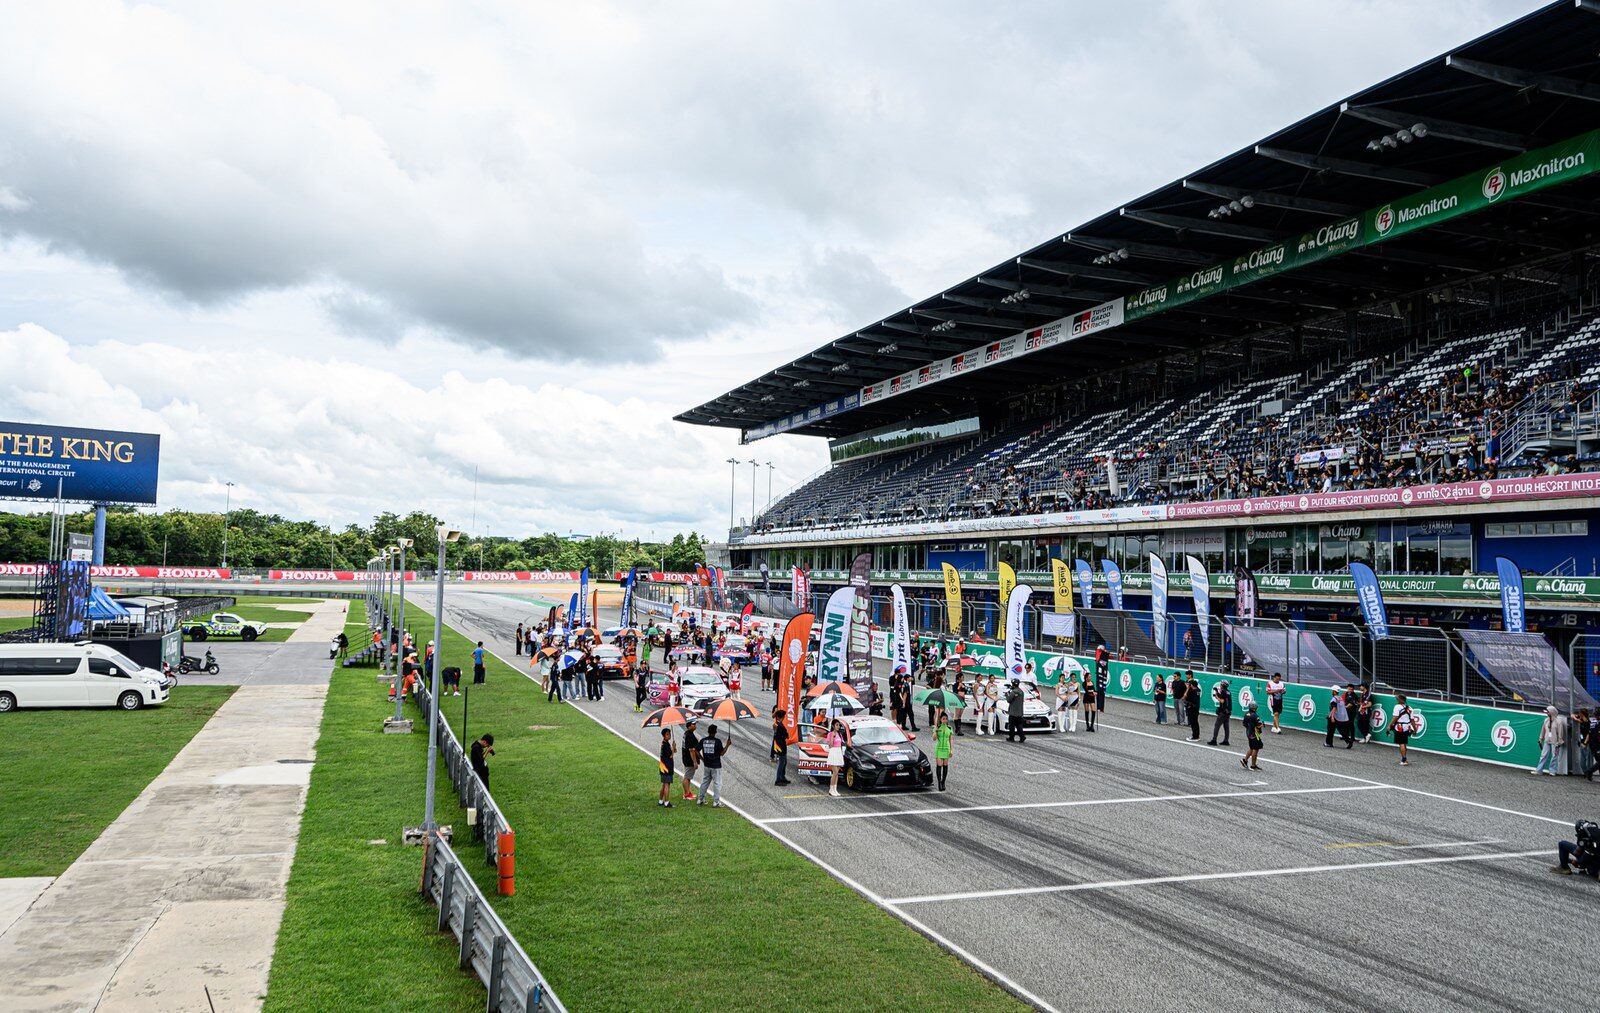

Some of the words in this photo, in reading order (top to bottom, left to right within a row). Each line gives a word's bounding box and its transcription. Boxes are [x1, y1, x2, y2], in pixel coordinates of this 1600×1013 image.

[1510, 152, 1585, 187] Maxnitron
[1398, 195, 1458, 224] Maxnitron
[1317, 220, 1359, 247] Chang
[1248, 247, 1285, 270] Chang
[1191, 267, 1223, 289] Chang
[1140, 287, 1167, 306] Chang
[1072, 321, 1091, 335] GR
[1025, 338, 1042, 351] GR
[985, 351, 1000, 363] GR
[60, 437, 135, 463] KING
[22, 462, 71, 470] MANAGEMENT
[1497, 484, 1514, 493] PUT
[1514, 483, 1532, 493] OUR
[1571, 479, 1593, 490] INTO
[1363, 495, 1378, 503] INTO
[1380, 493, 1398, 502] FOOD
[1256, 530, 1287, 539] Maxnitron
[1331, 524, 1361, 539] Chang
[88, 567, 140, 576] ONDA
[157, 568, 222, 578] HONDA
[282, 571, 338, 580] HONDA
[472, 572, 518, 581] HONDA
[530, 572, 573, 580] HONDA
[663, 574, 698, 582] HONA
[1124, 574, 1142, 587] Chang
[1269, 576, 1290, 588] Chang
[1312, 576, 1340, 592] Chang
[1402, 581, 1436, 590] CIRCUIT
[1476, 578, 1500, 591] Chan
[1551, 579, 1586, 594] Chang
[898, 601, 906, 641] Lubricants
[1451, 609, 1465, 621] 17
[1561, 614, 1577, 625] 18
[898, 643, 908, 663] ptt
[1013, 641, 1023, 663] ptt
[850, 668, 870, 680] WISE
